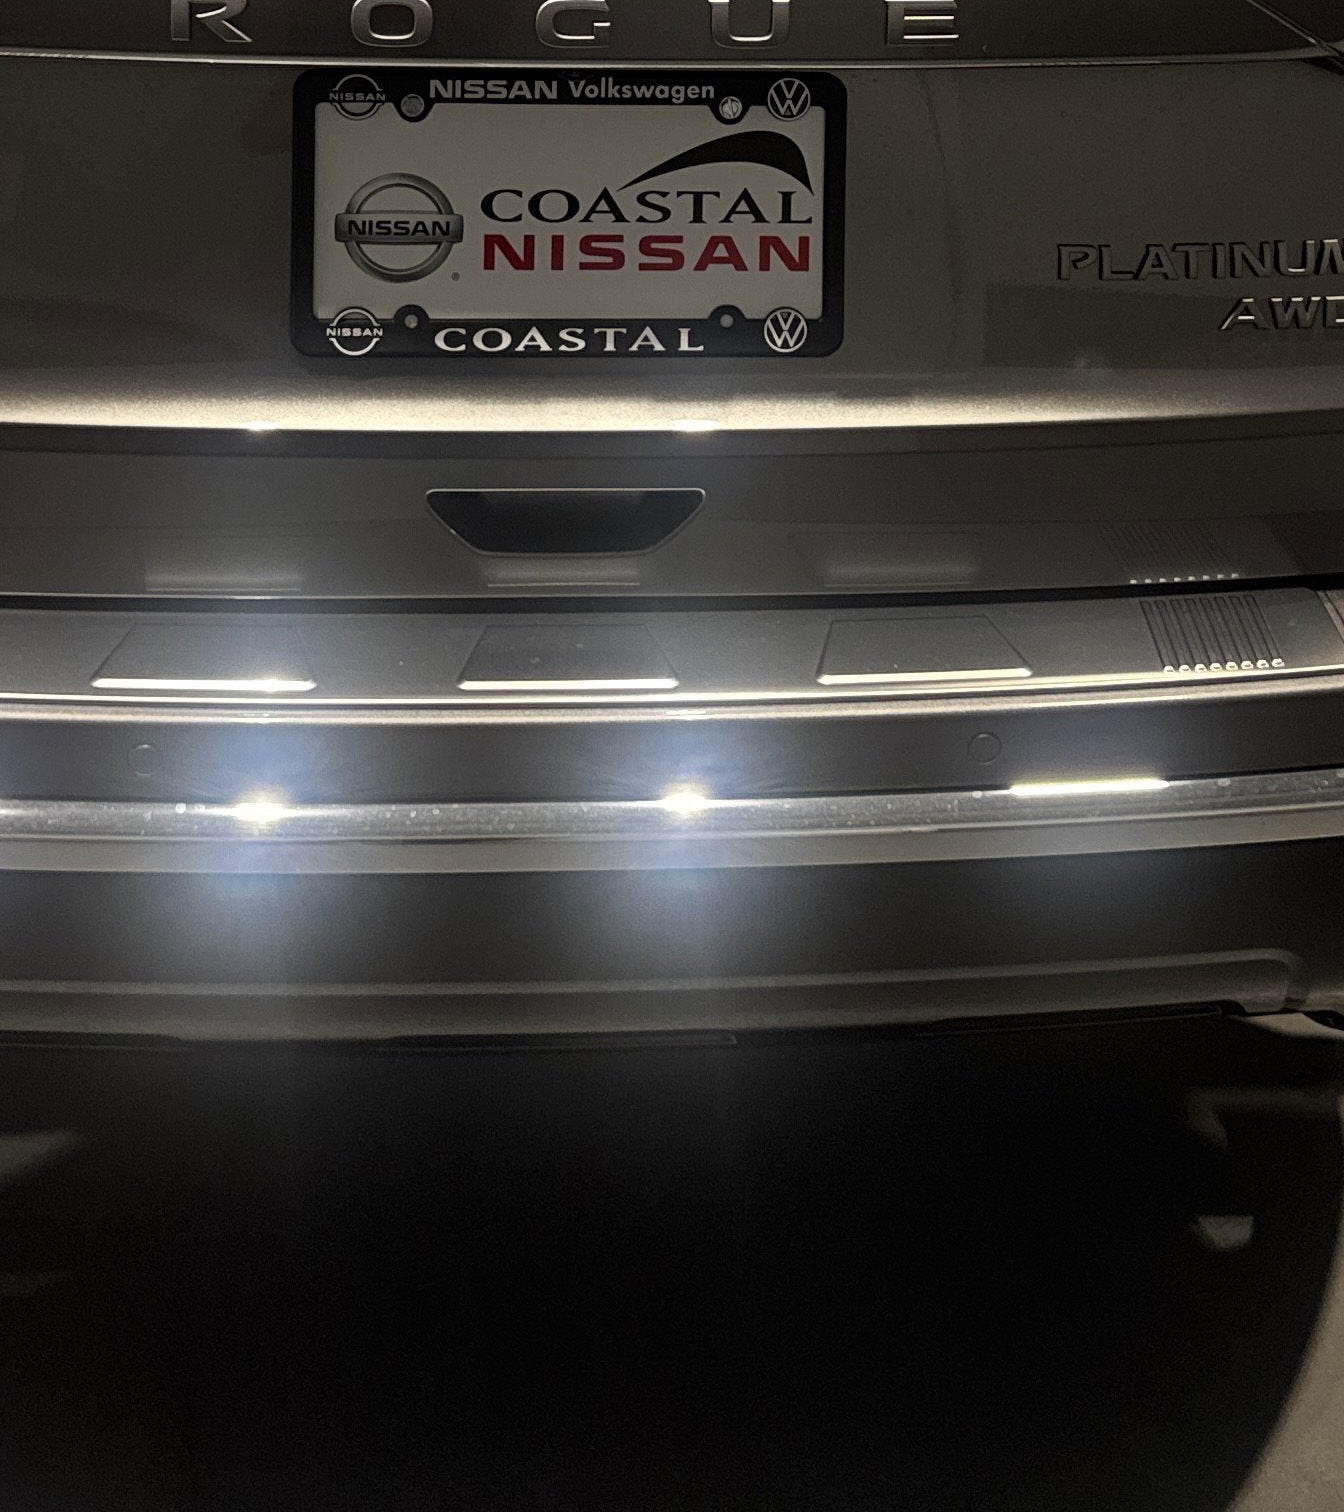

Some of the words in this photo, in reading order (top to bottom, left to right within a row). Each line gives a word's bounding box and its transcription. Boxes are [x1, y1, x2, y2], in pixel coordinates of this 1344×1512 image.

[329, 91, 386, 103] NISSAN
[429, 79, 558, 100] NISSAN
[568, 77, 716, 103] Volkswagen
[480, 187, 813, 225] COASTAL
[347, 218, 451, 238] NISSAN
[483, 233, 811, 272] NISSAN
[326, 326, 383, 337] NISSAN
[434, 327, 705, 353] COASTAL
